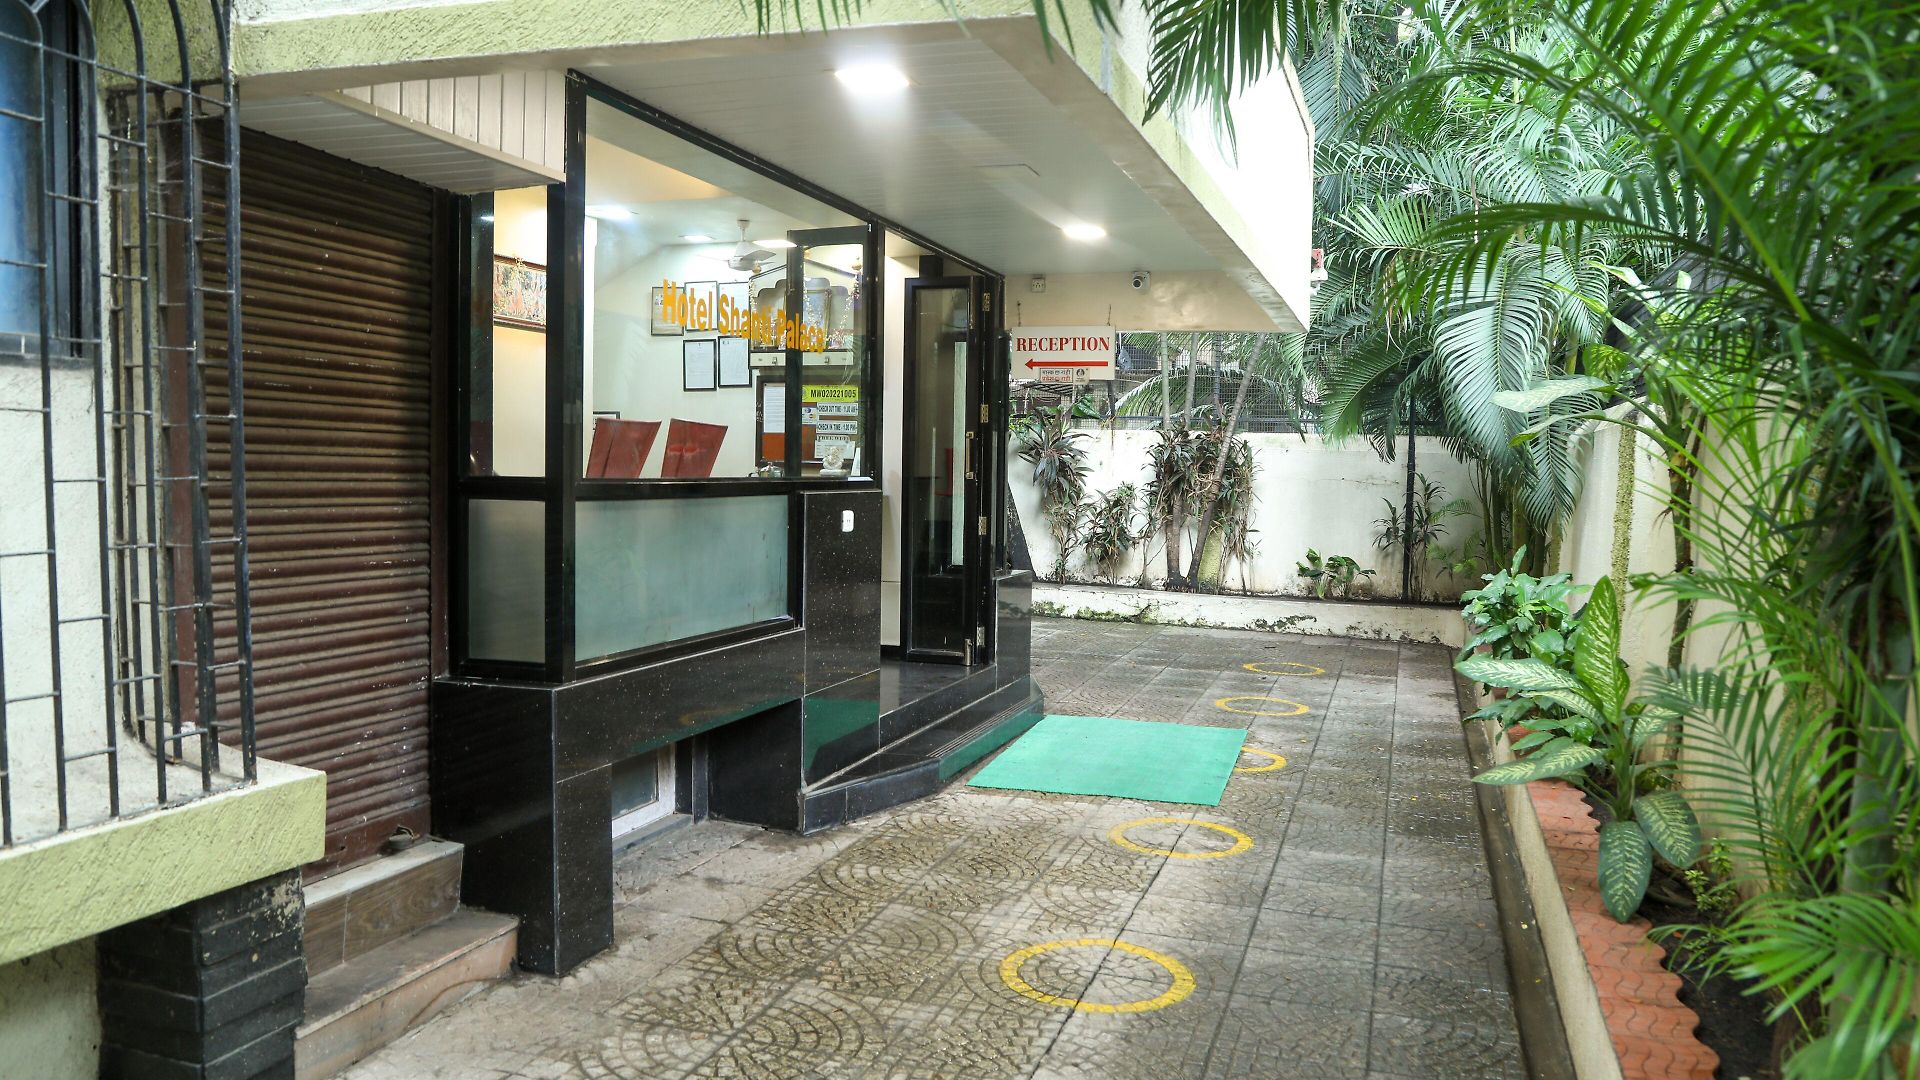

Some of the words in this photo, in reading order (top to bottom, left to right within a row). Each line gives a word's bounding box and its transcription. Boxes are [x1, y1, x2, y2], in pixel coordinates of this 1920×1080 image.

[662, 279, 713, 332] Hotel
[718, 293, 773, 345] Shanti
[777, 308, 825, 354] Palace
[1016, 336, 1110, 352] RECEPTION
[818, 423, 828, 431] CHECK
[833, 423, 841, 431] TIME
